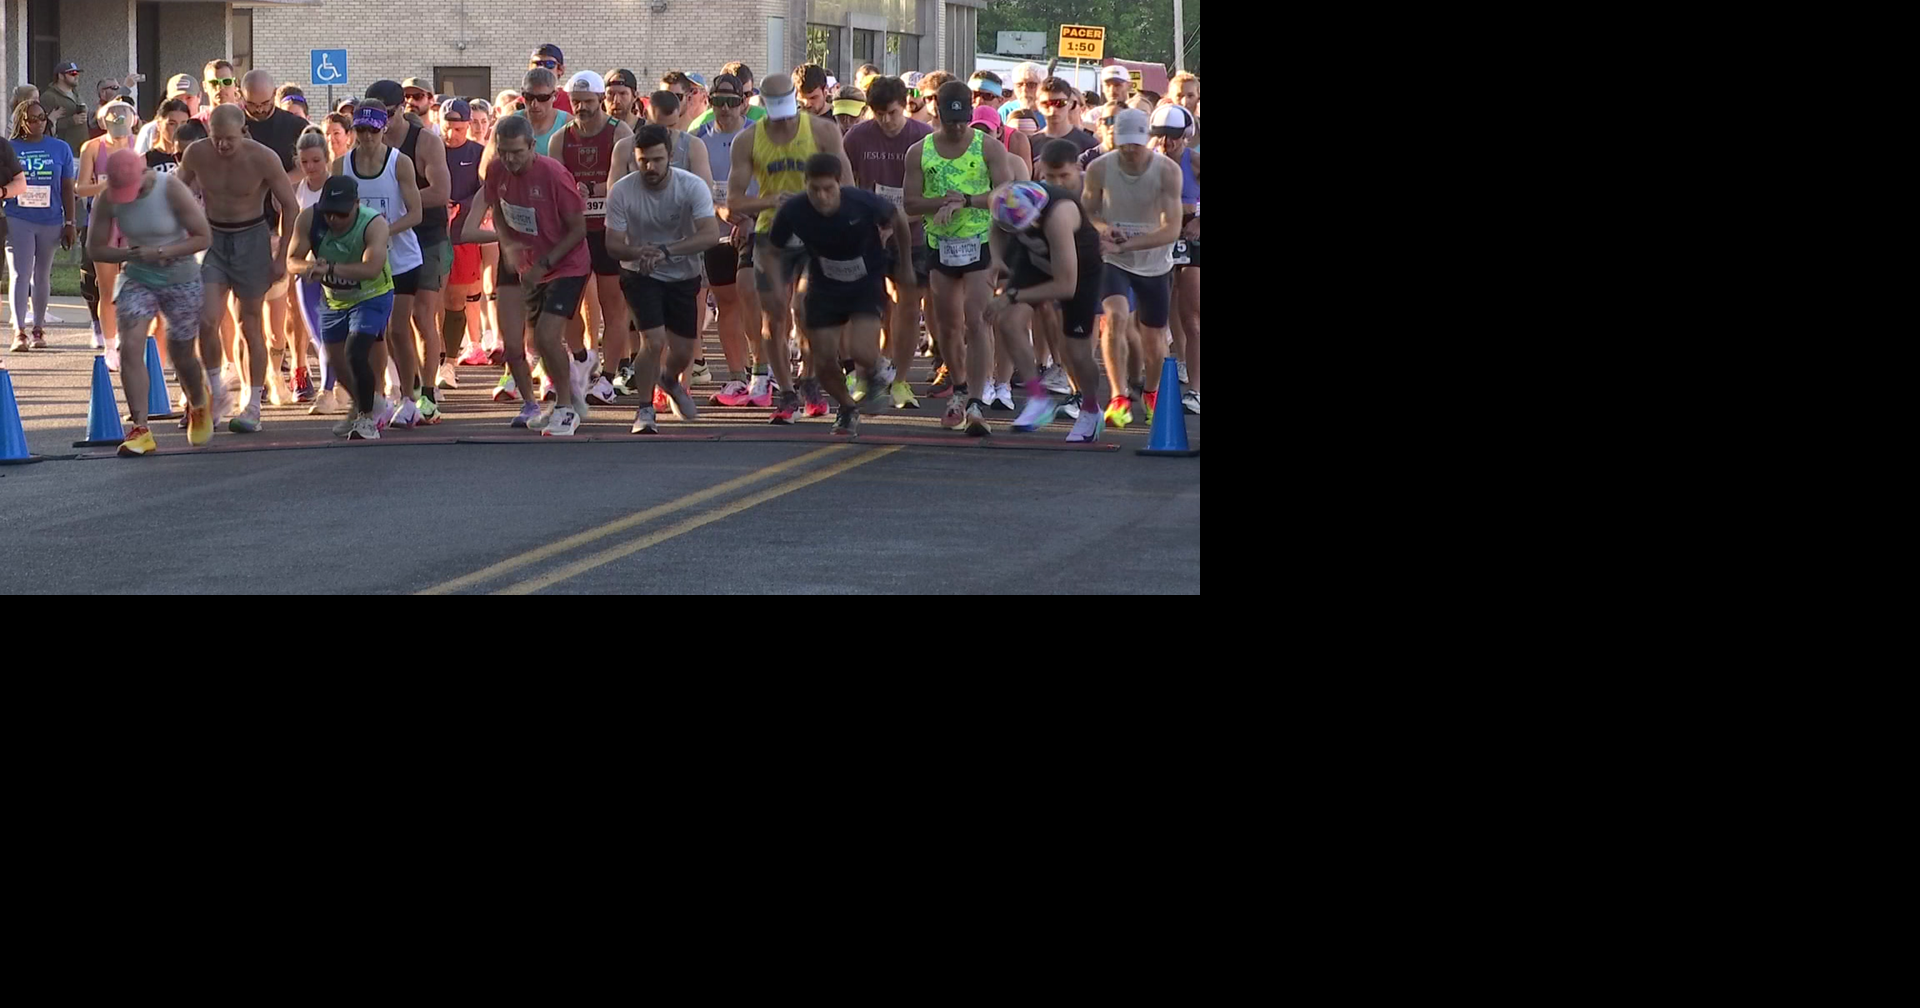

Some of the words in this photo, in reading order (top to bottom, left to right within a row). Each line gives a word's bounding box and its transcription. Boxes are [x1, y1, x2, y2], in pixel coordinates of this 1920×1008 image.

[1063, 27, 1102, 38] PACER
[1067, 42, 1096, 52] 1:50
[864, 151, 886, 160] JESUS
[26, 158, 45, 171] 15
[587, 201, 604, 211] 397
